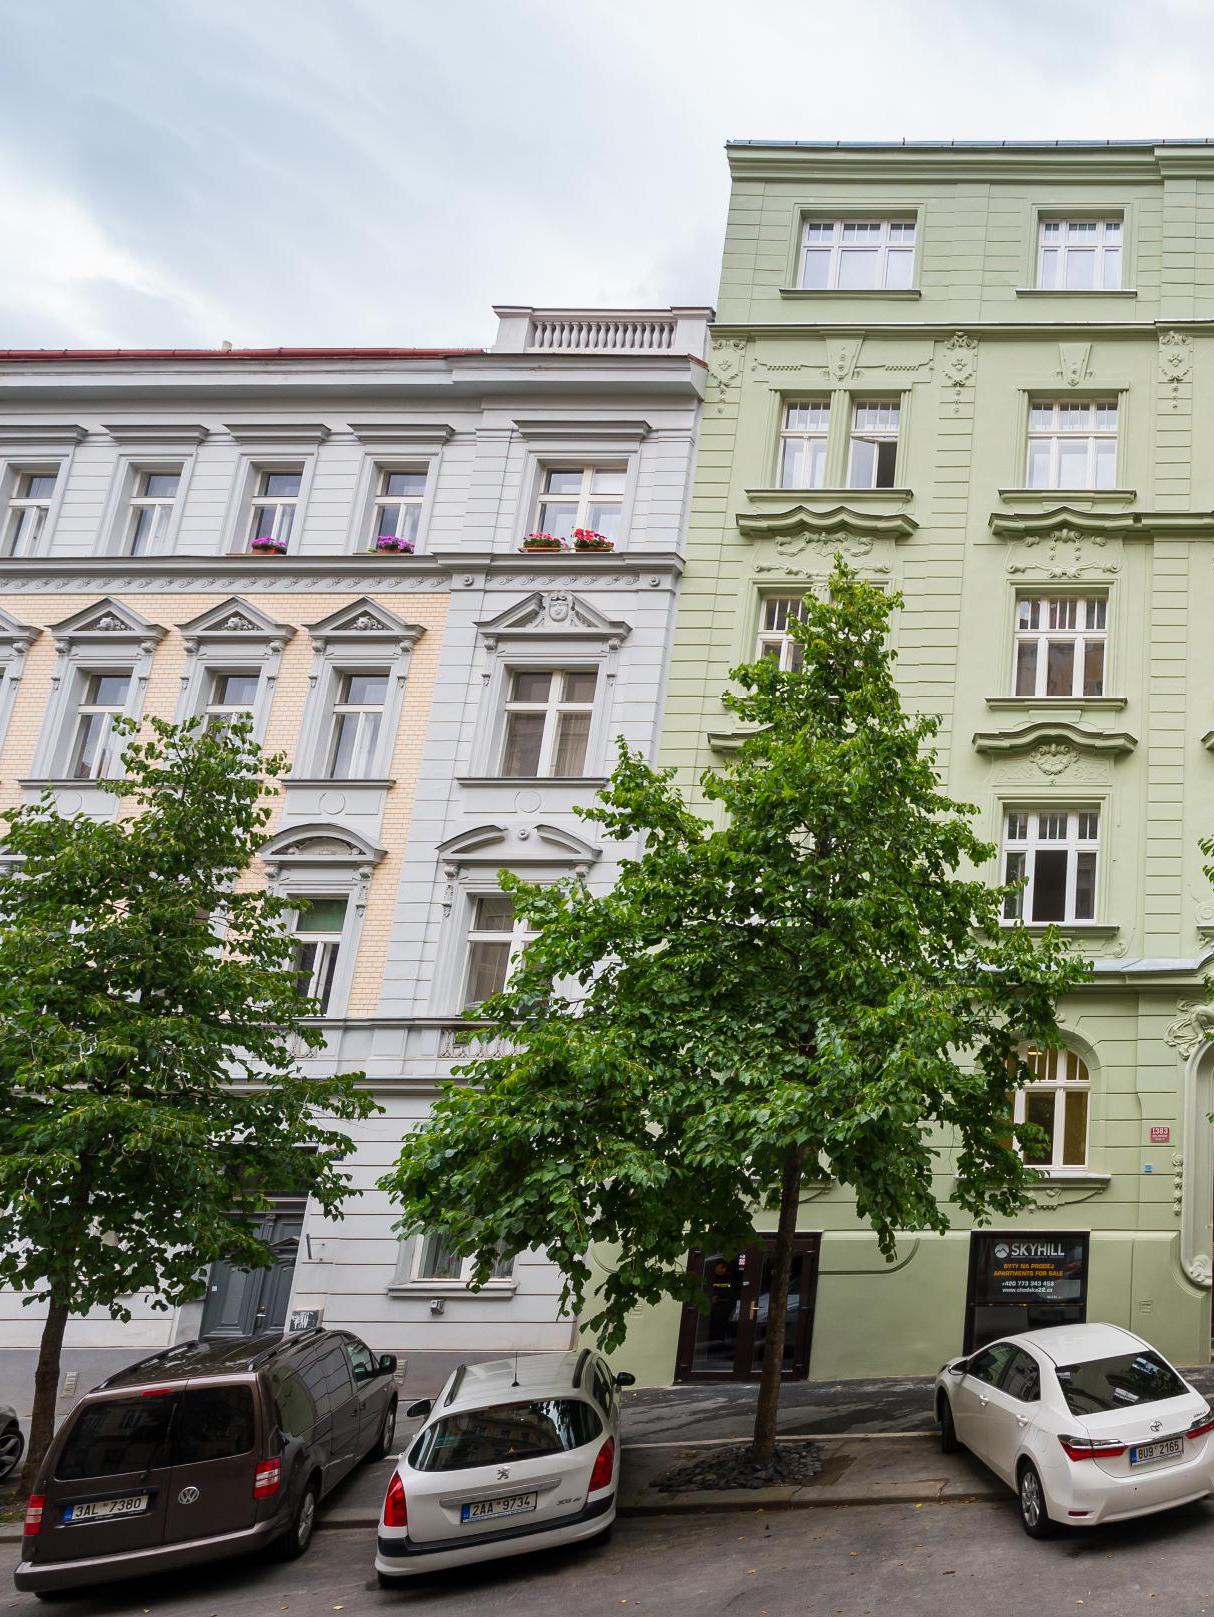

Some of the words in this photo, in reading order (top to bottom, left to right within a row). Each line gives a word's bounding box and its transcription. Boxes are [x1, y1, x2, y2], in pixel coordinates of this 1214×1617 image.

[1152, 1127, 1168, 1135] 1383
[1011, 1243, 1065, 1256] SKYHILL
[1160, 1440, 1180, 1455] 2165
[75, 1503, 99, 1518] 3AL
[109, 1497, 141, 1513] 7380
[472, 1502, 494, 1517] 2AA
[502, 1495, 531, 1511] 9734
